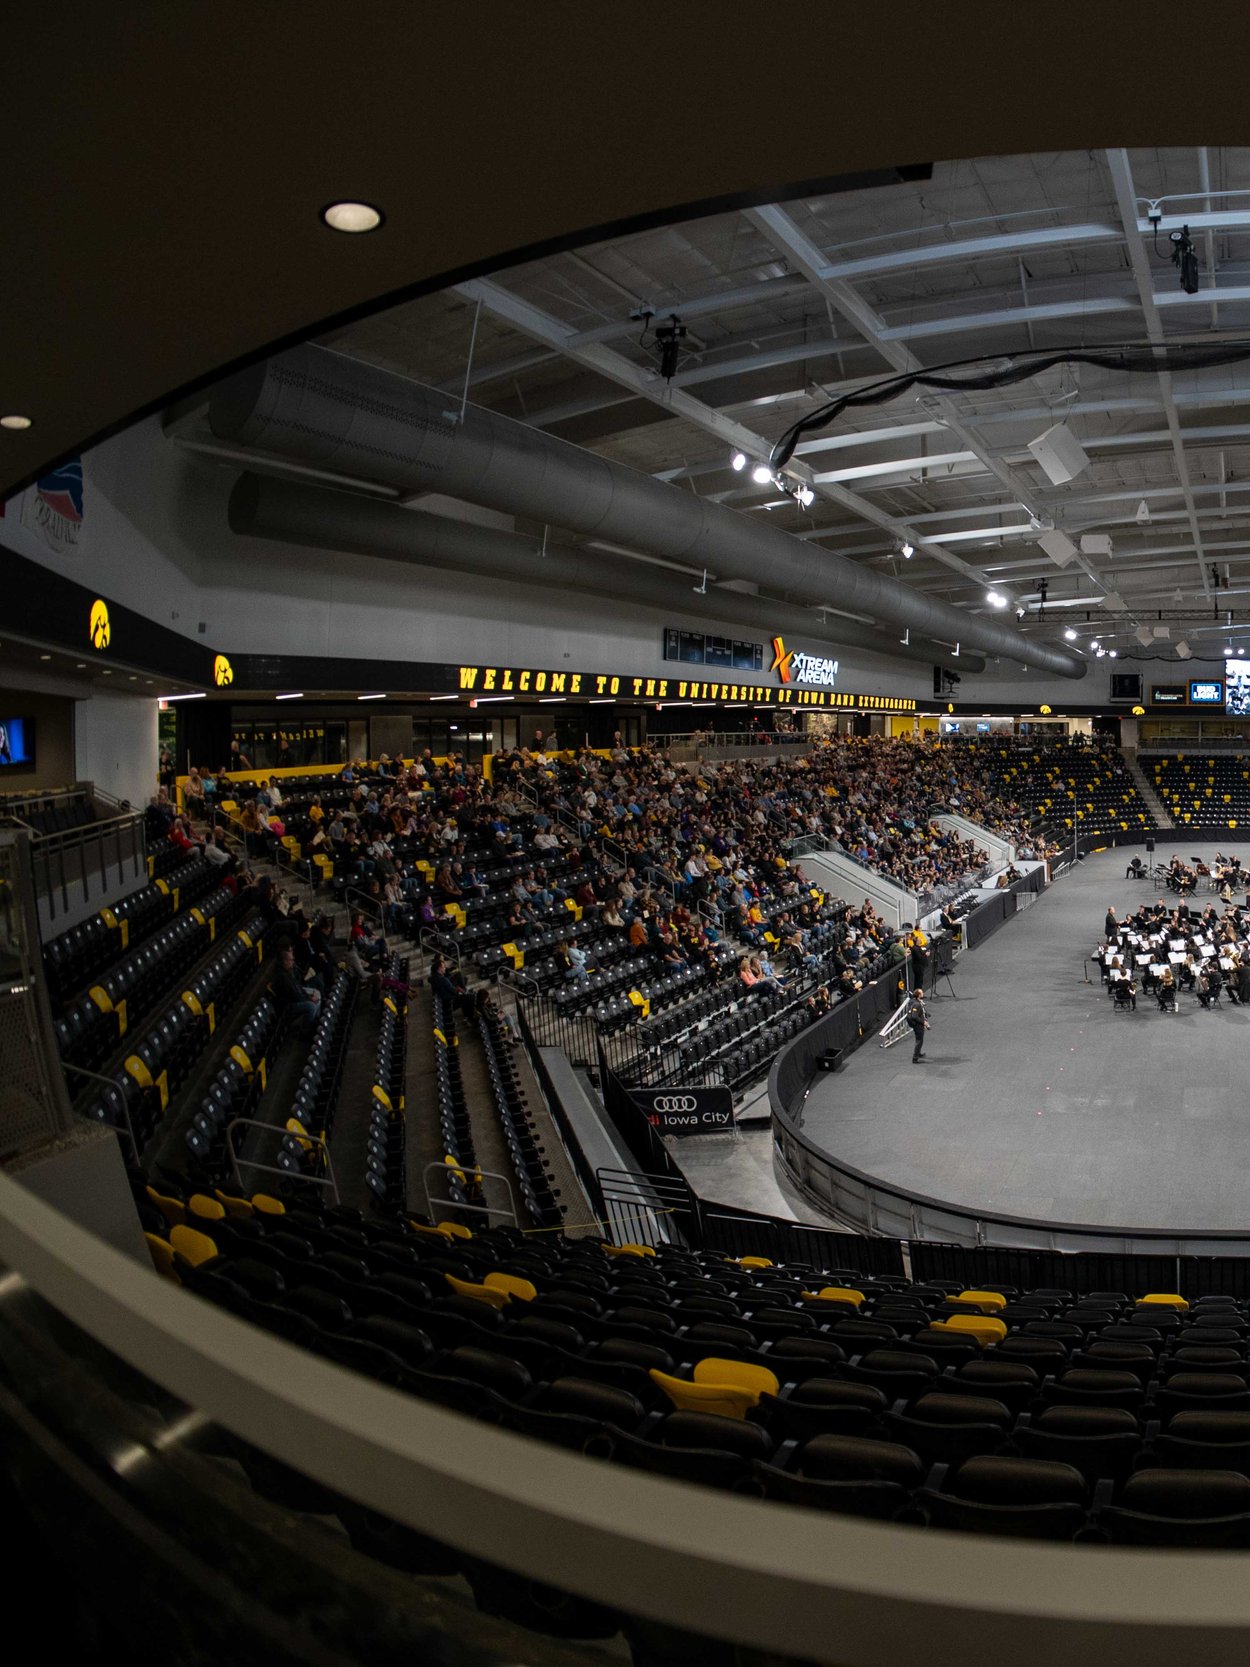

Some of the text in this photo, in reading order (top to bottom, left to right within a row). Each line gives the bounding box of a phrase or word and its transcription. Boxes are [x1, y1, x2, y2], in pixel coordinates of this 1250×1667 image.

[791, 653, 838, 674] XTREAM
[796, 669, 835, 686] ARENA
[460, 668, 916, 710] WELCOME TO THE UNIVERSITY OF IOWA BAND EXTRAVAGANZA
[663, 1114, 699, 1126] Iowa
[702, 1111, 730, 1124] City
